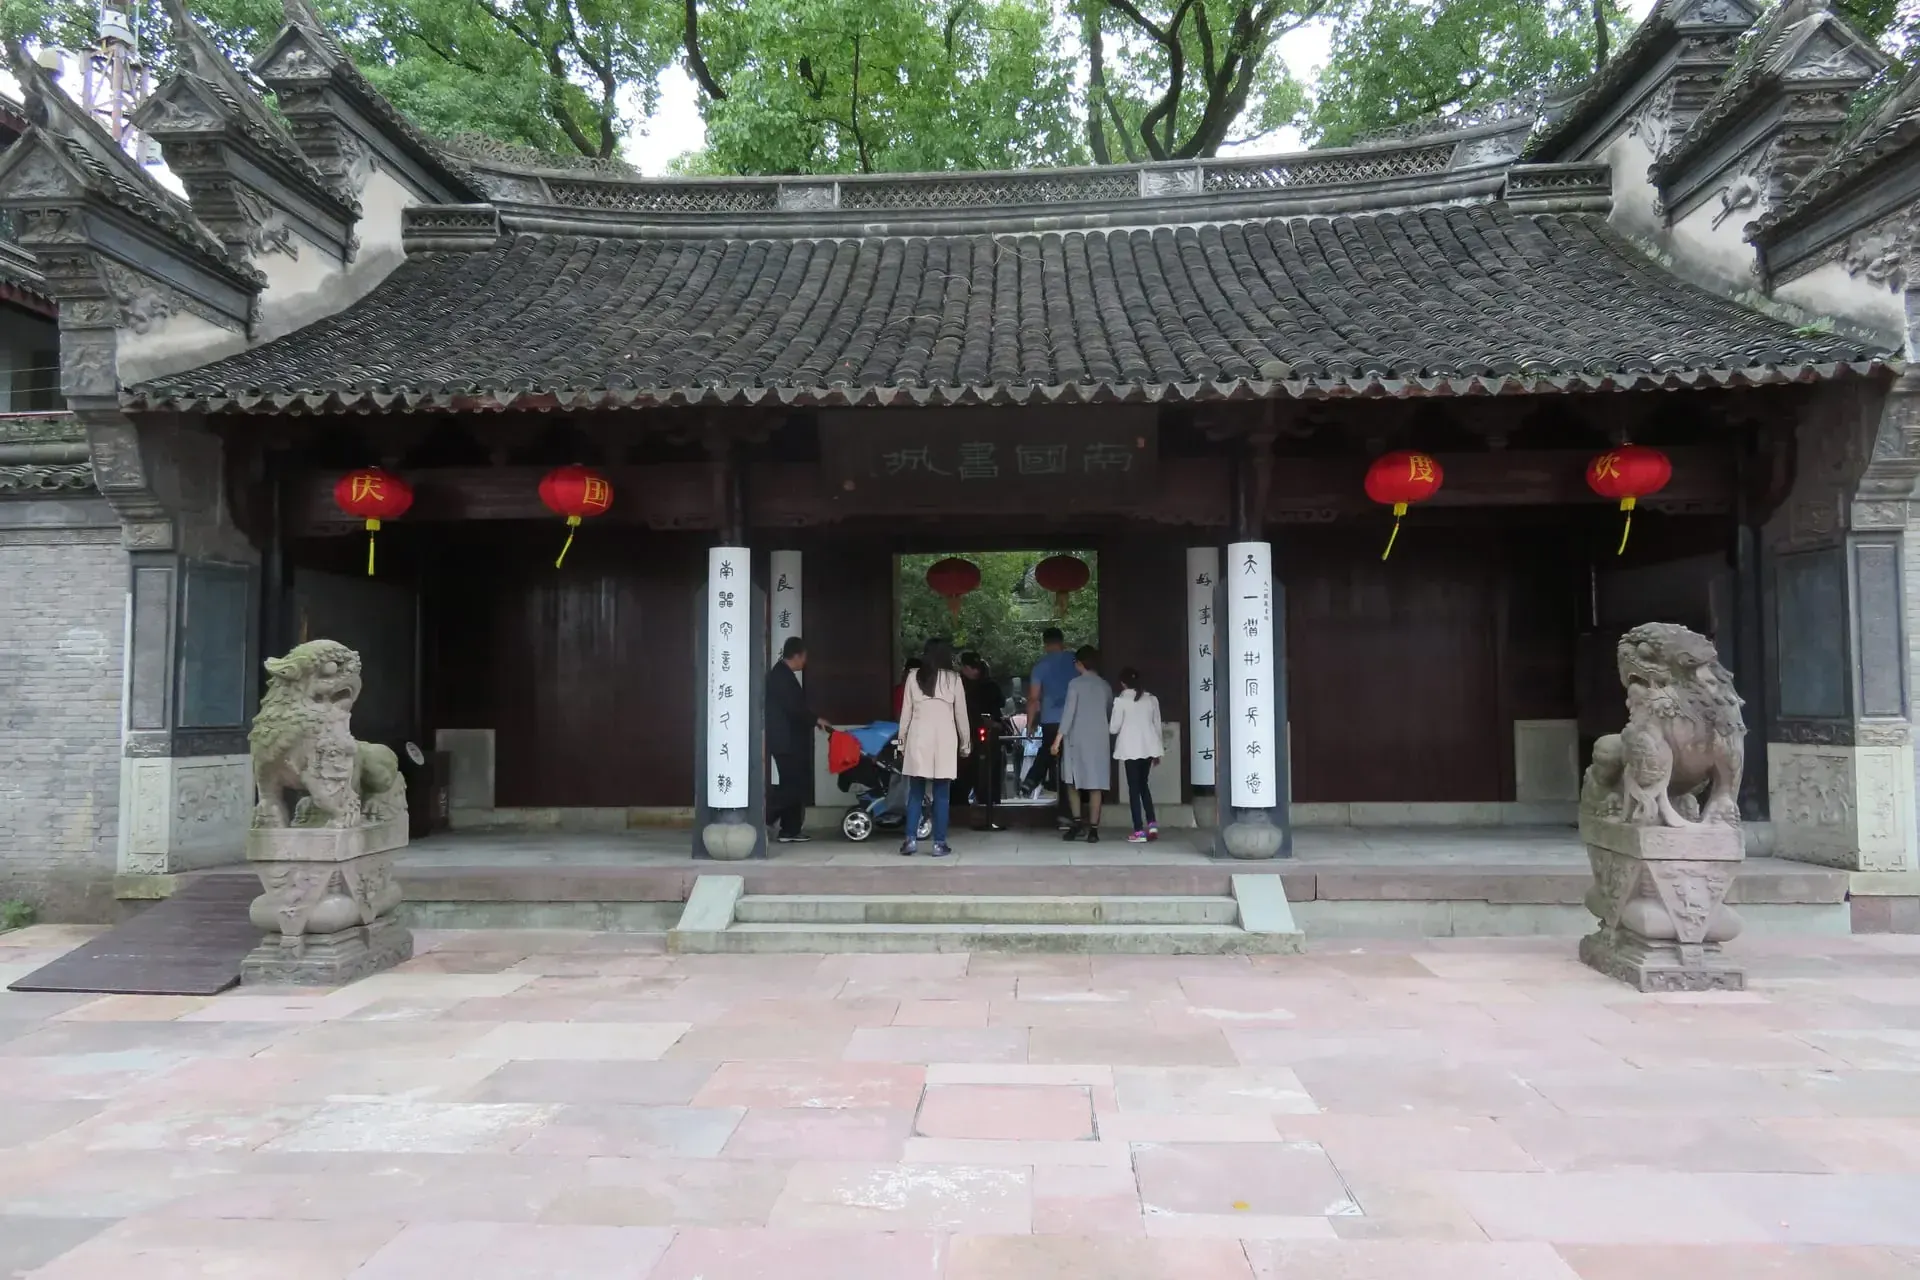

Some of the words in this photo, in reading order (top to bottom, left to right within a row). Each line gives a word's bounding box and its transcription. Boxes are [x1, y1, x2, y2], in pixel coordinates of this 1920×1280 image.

[1407, 454, 1435, 484] 度
[351, 474, 385, 503] 庆
[582, 475, 609, 508] 国
